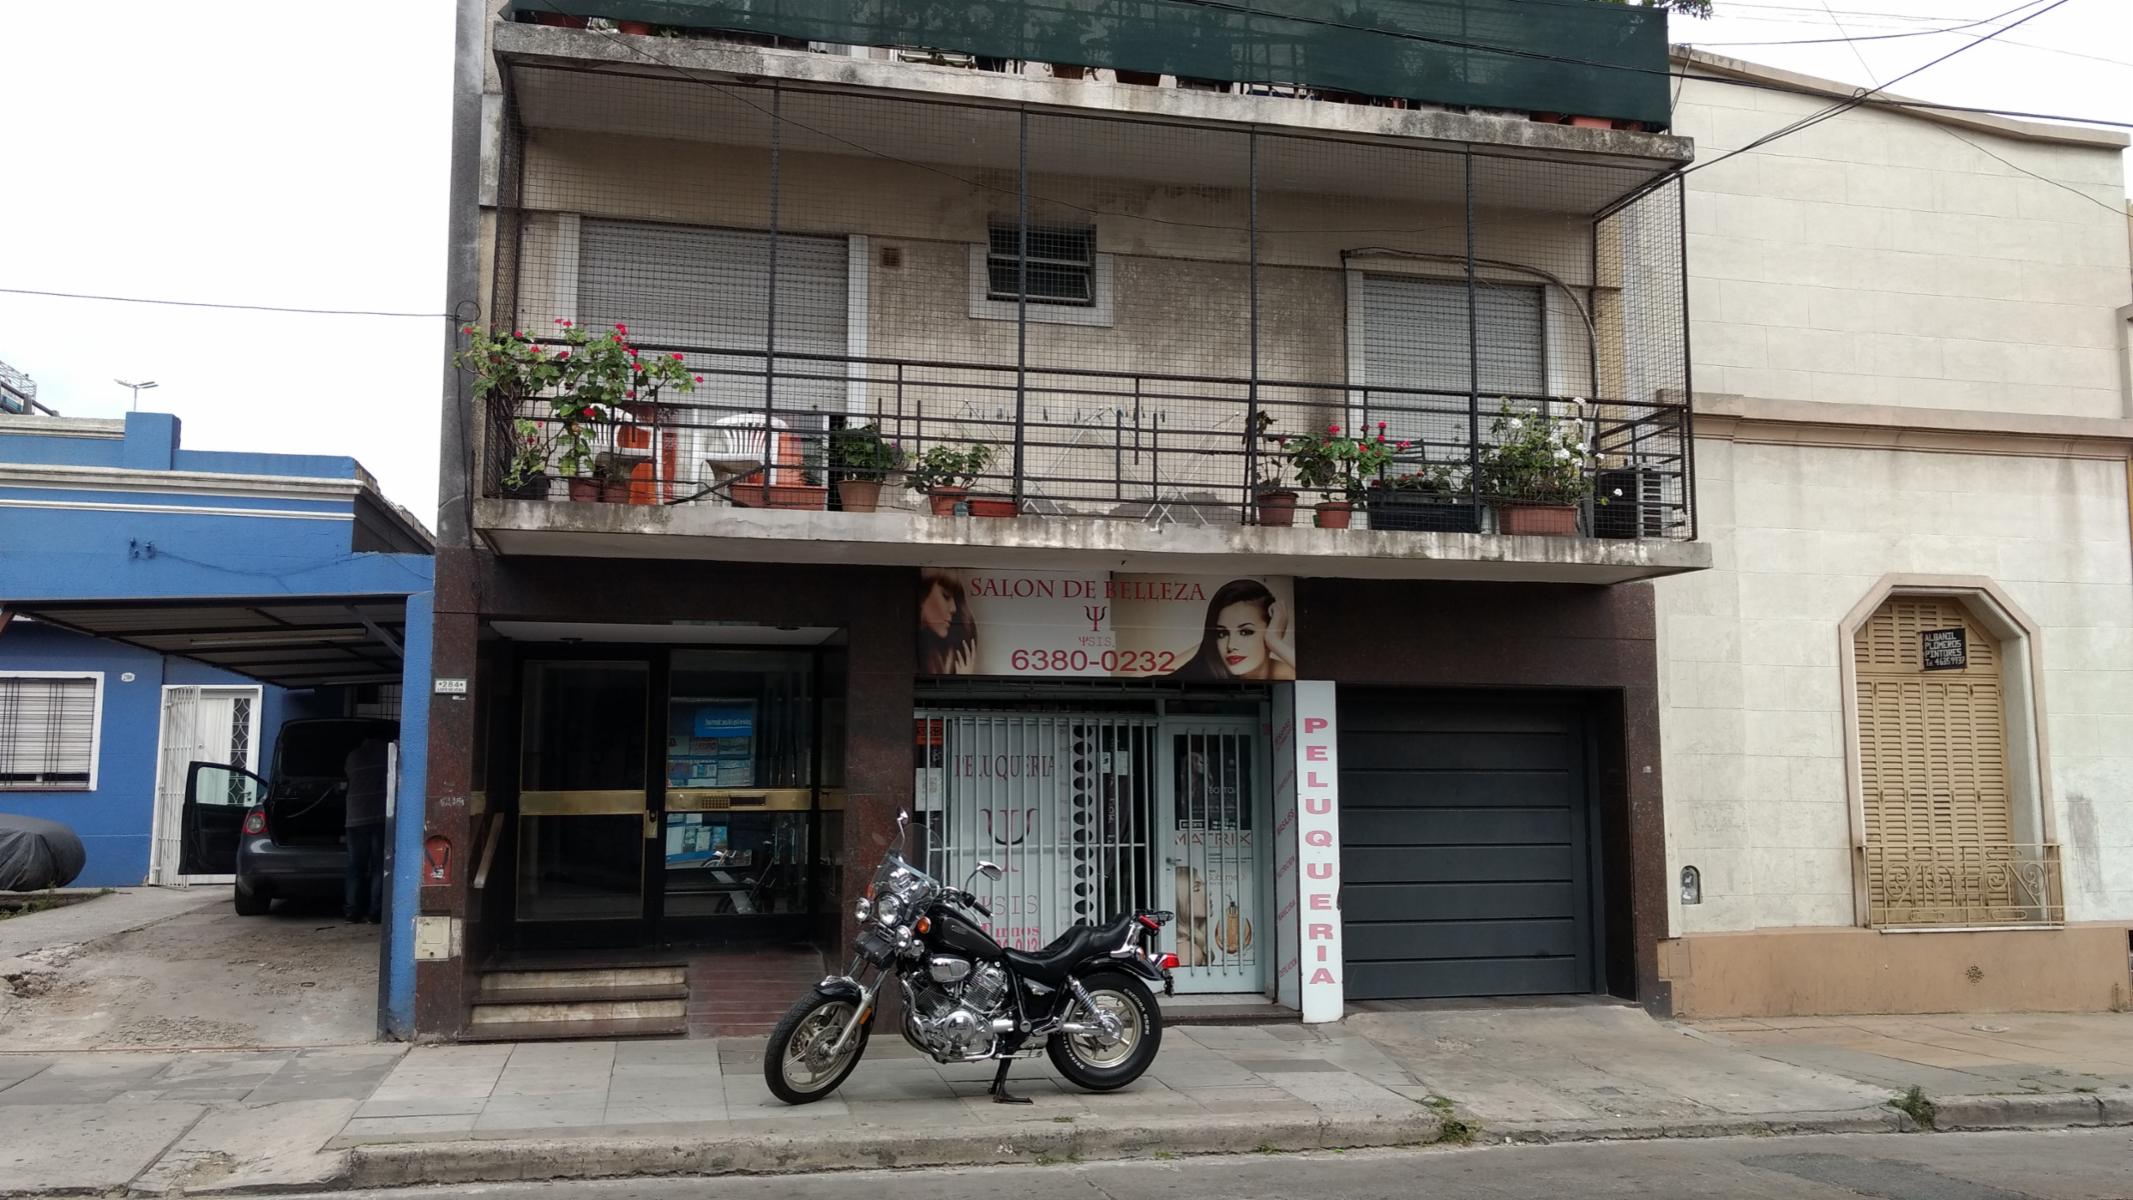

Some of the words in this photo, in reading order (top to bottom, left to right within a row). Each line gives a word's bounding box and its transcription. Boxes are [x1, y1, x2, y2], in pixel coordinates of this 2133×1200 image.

[970, 577, 1055, 598] SALON
[1063, 579, 1096, 599] DE
[1103, 581, 1207, 601] BELLEZA
[1925, 640, 1962, 650] PLOMEROS
[1925, 648, 1963, 658] PINTORES
[1010, 649, 1176, 672] 6380-0232
[954, 754, 1055, 781] PEUQURIA
[1303, 717, 1336, 985] PELUQUERIA
